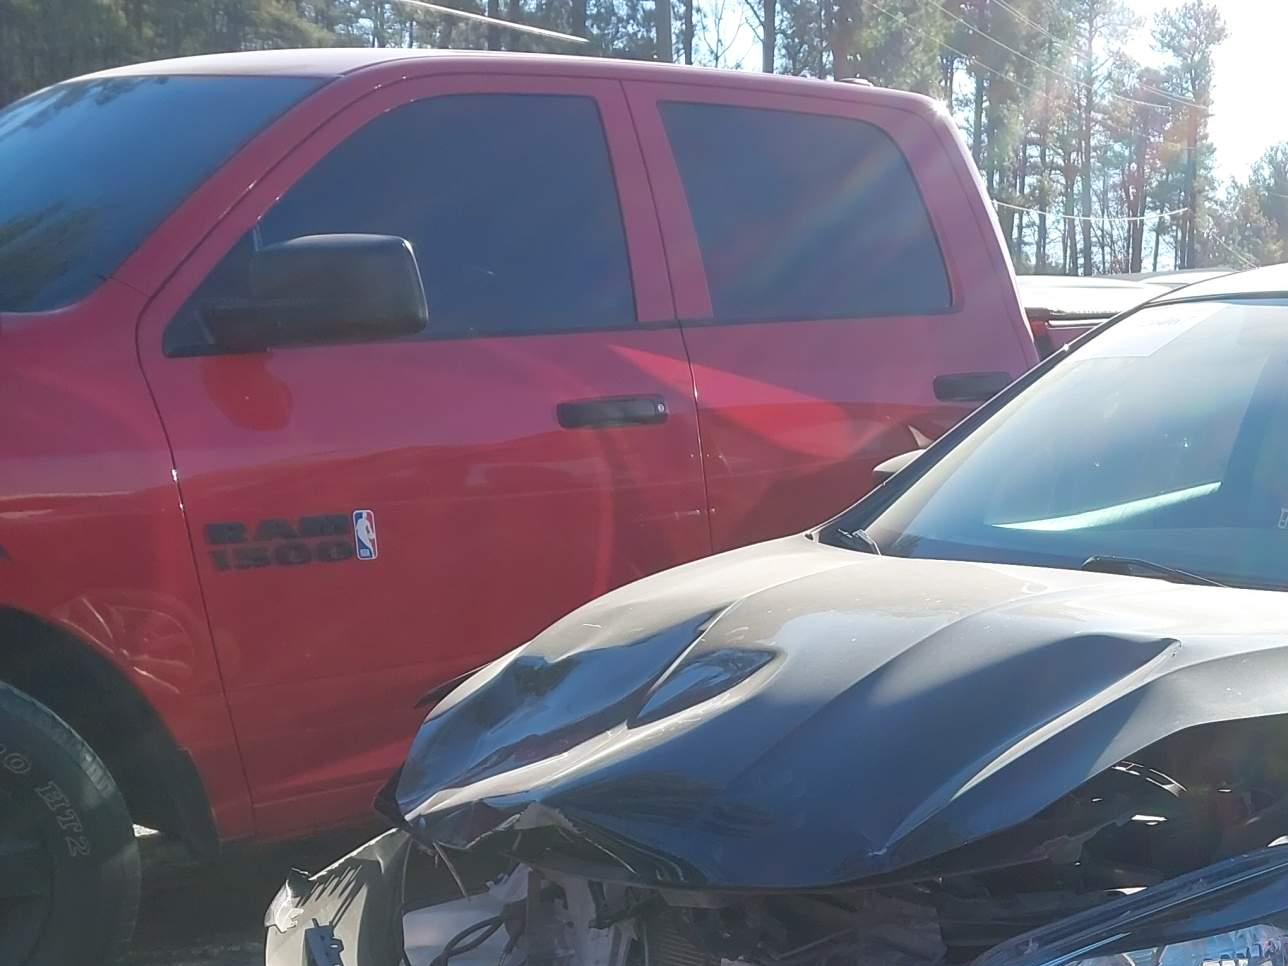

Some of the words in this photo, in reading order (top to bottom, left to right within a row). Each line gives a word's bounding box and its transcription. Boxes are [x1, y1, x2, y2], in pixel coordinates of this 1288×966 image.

[205, 514, 350, 544] RAM
[209, 540, 353, 571] 1500
[34, 781, 89, 856] HT2
